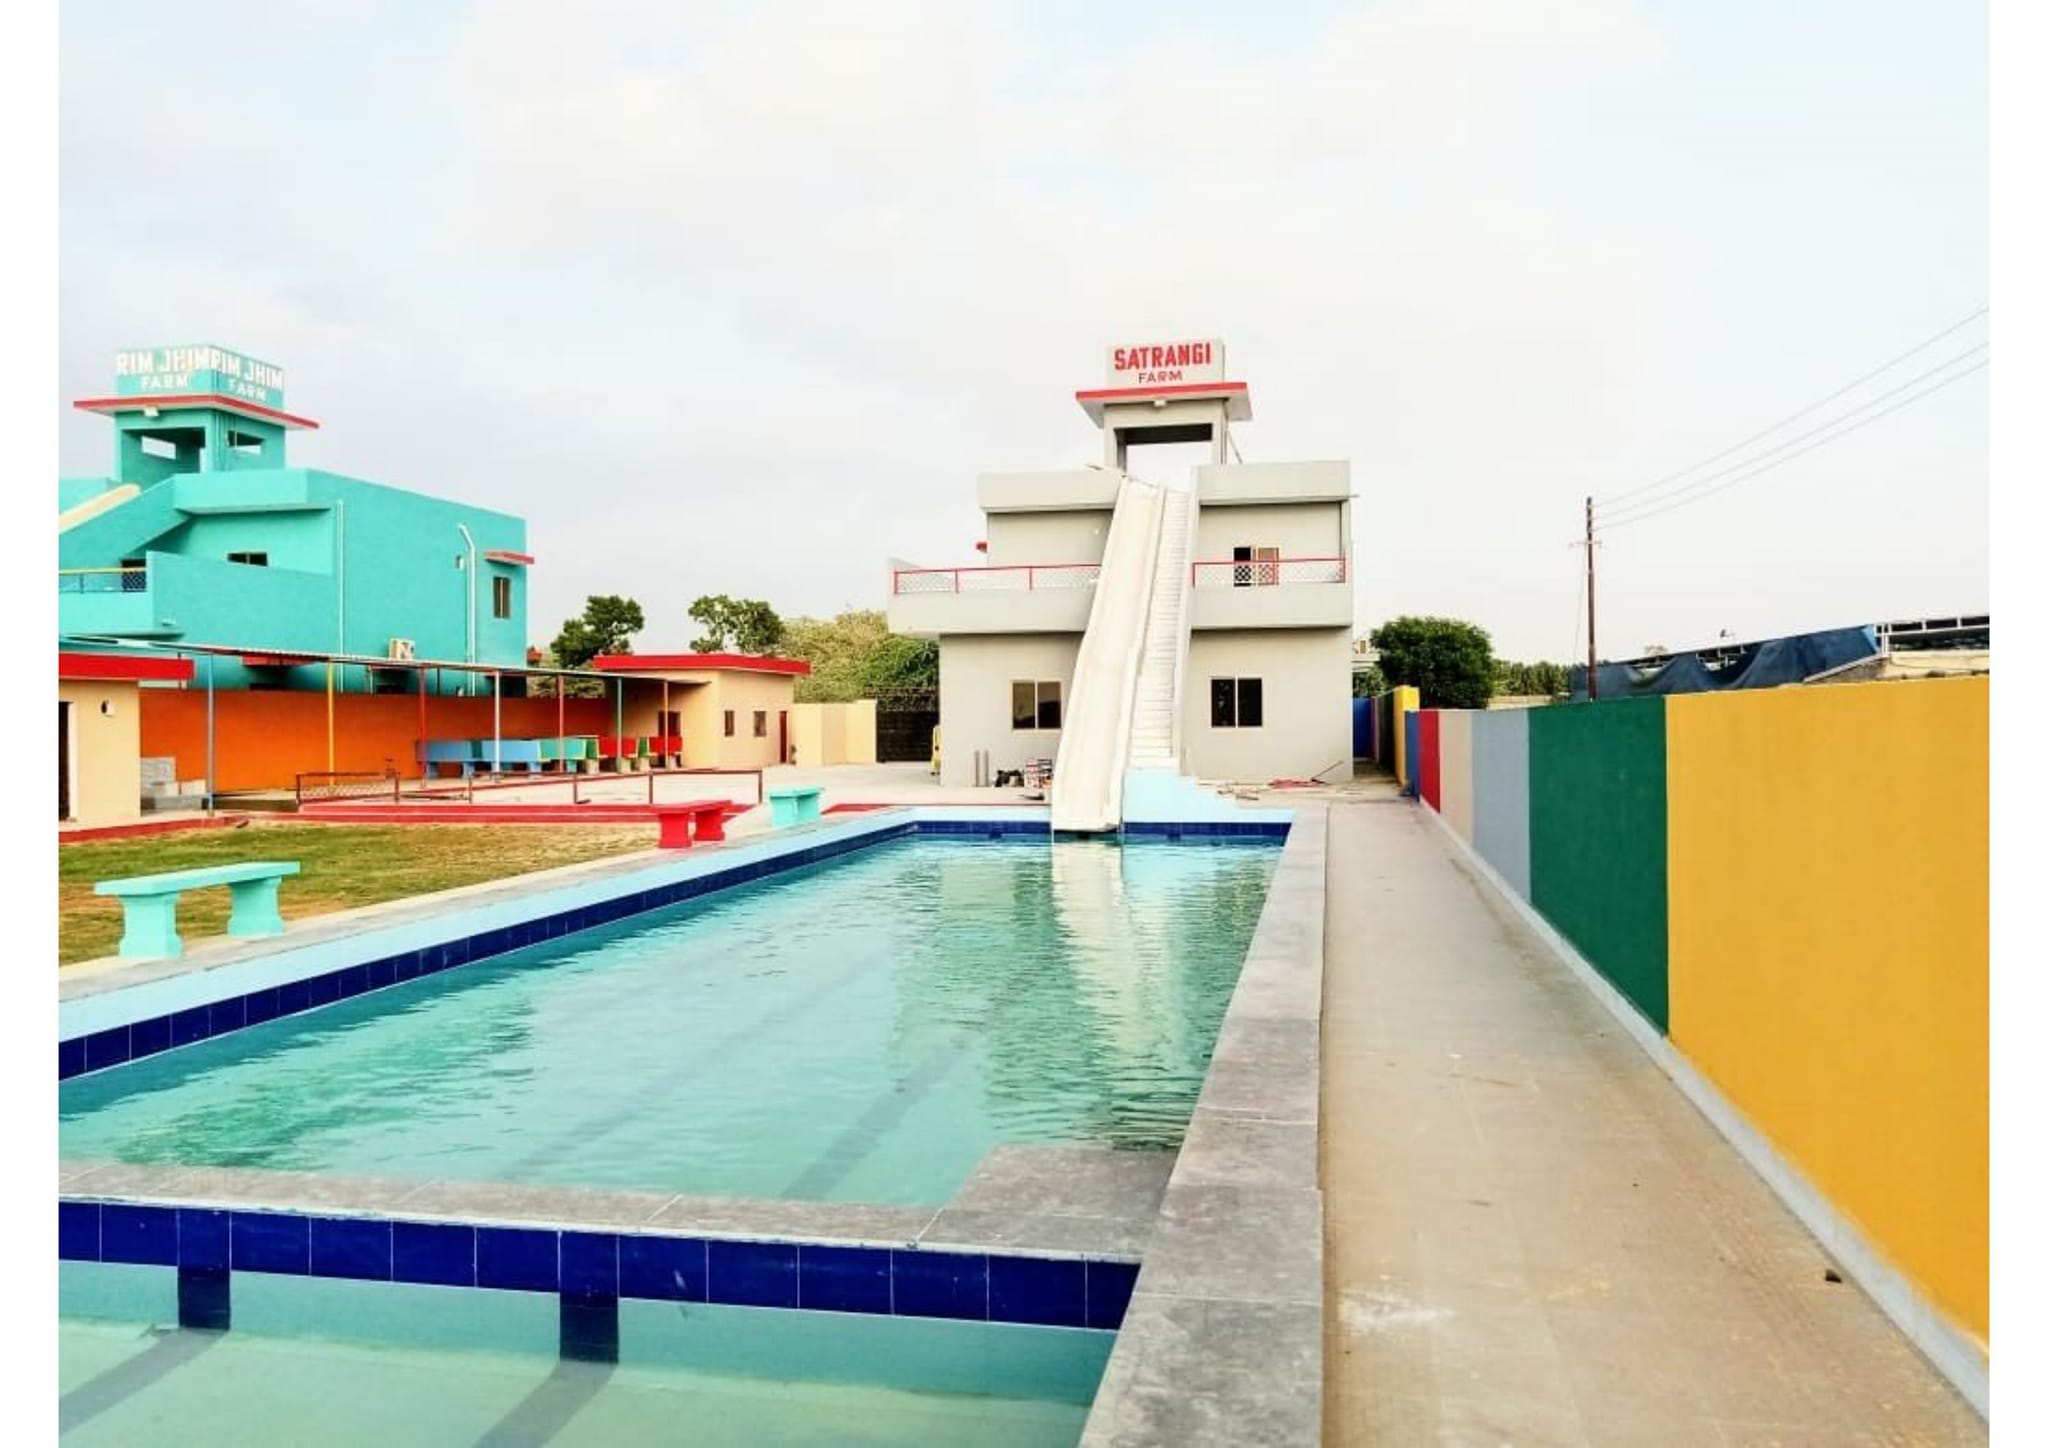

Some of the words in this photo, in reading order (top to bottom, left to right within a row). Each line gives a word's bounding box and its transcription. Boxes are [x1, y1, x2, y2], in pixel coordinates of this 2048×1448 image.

[117, 352, 153, 375] RIM
[161, 348, 209, 373] JHIM
[1114, 342, 1211, 370] SATRANGI
[141, 373, 188, 388] FARM
[211, 349, 241, 377] RIM
[245, 359, 283, 388] JHIM
[1138, 370, 1183, 384] FARM
[230, 379, 266, 400] FARM
